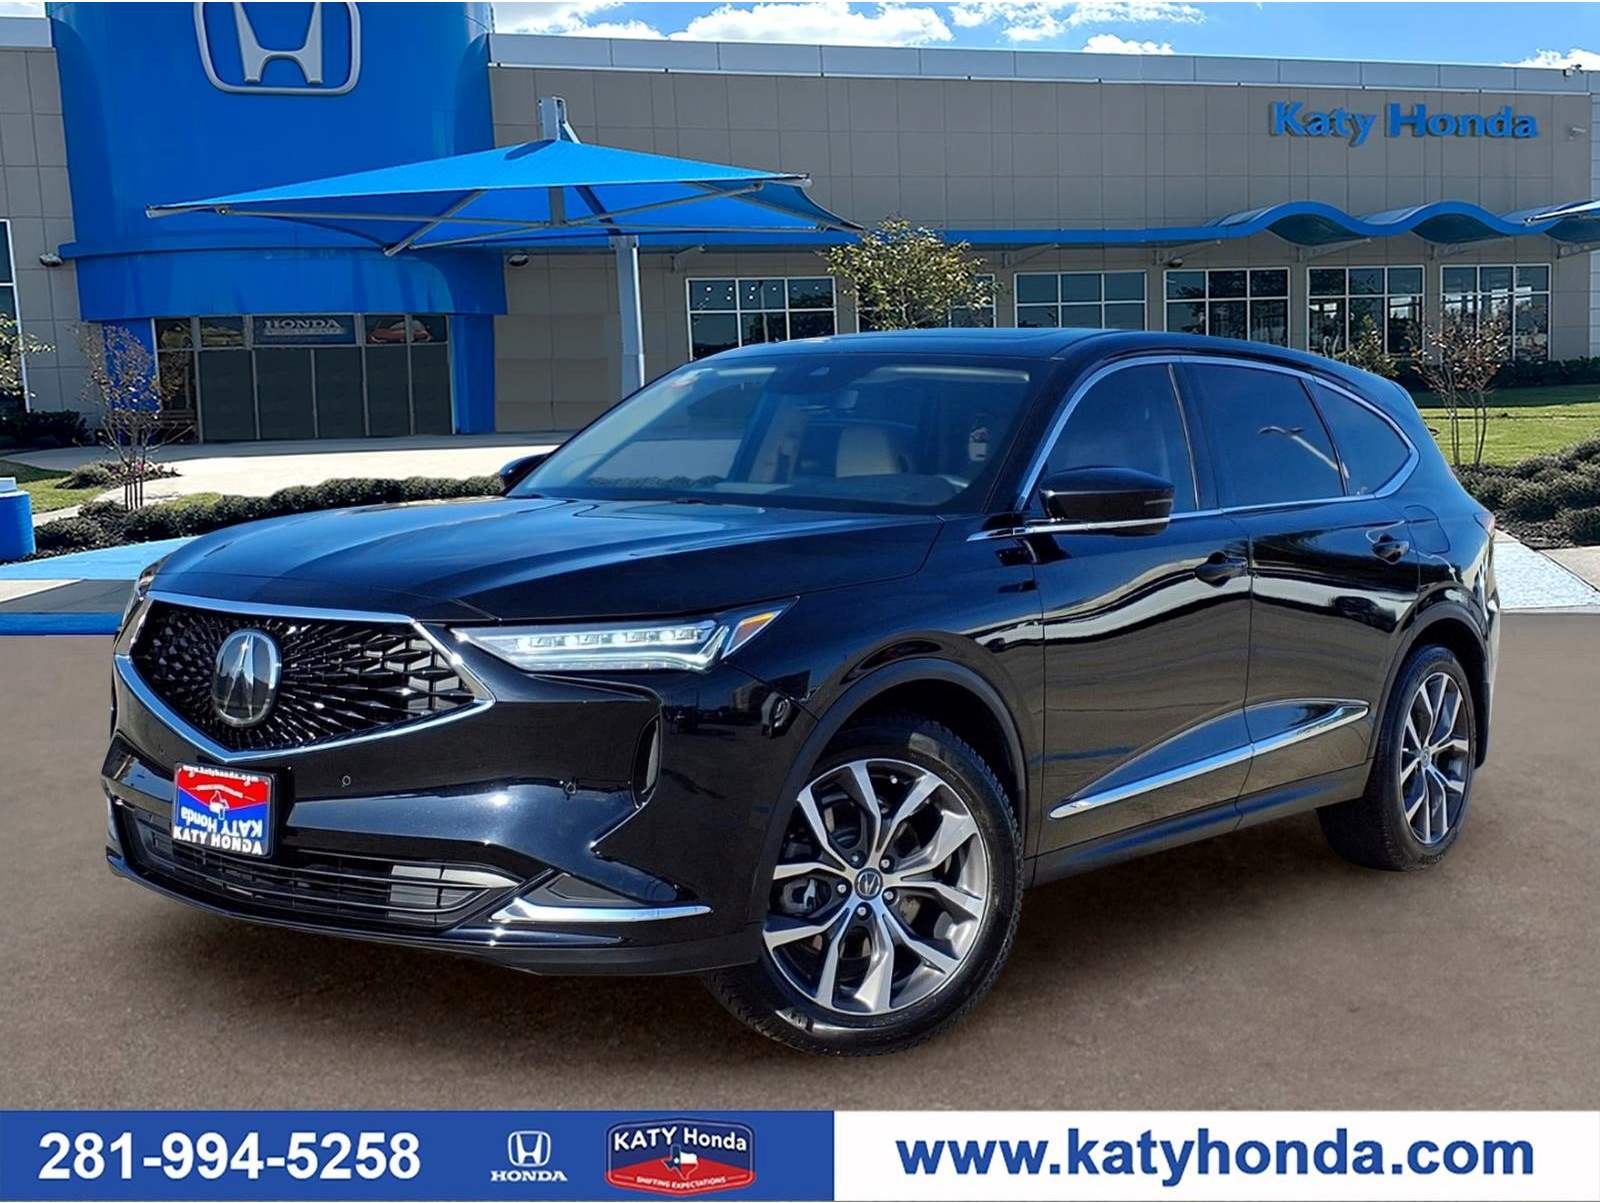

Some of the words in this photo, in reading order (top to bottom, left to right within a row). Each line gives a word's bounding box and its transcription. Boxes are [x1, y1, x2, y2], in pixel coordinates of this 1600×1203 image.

[1270, 101, 1377, 146] Katy
[1385, 103, 1540, 138] Honda
[263, 319, 342, 329] HONDA
[181, 807, 218, 833] Honda
[221, 819, 262, 838] KATY
[173, 826, 208, 844] KATY
[211, 833, 262, 855] HONDA
